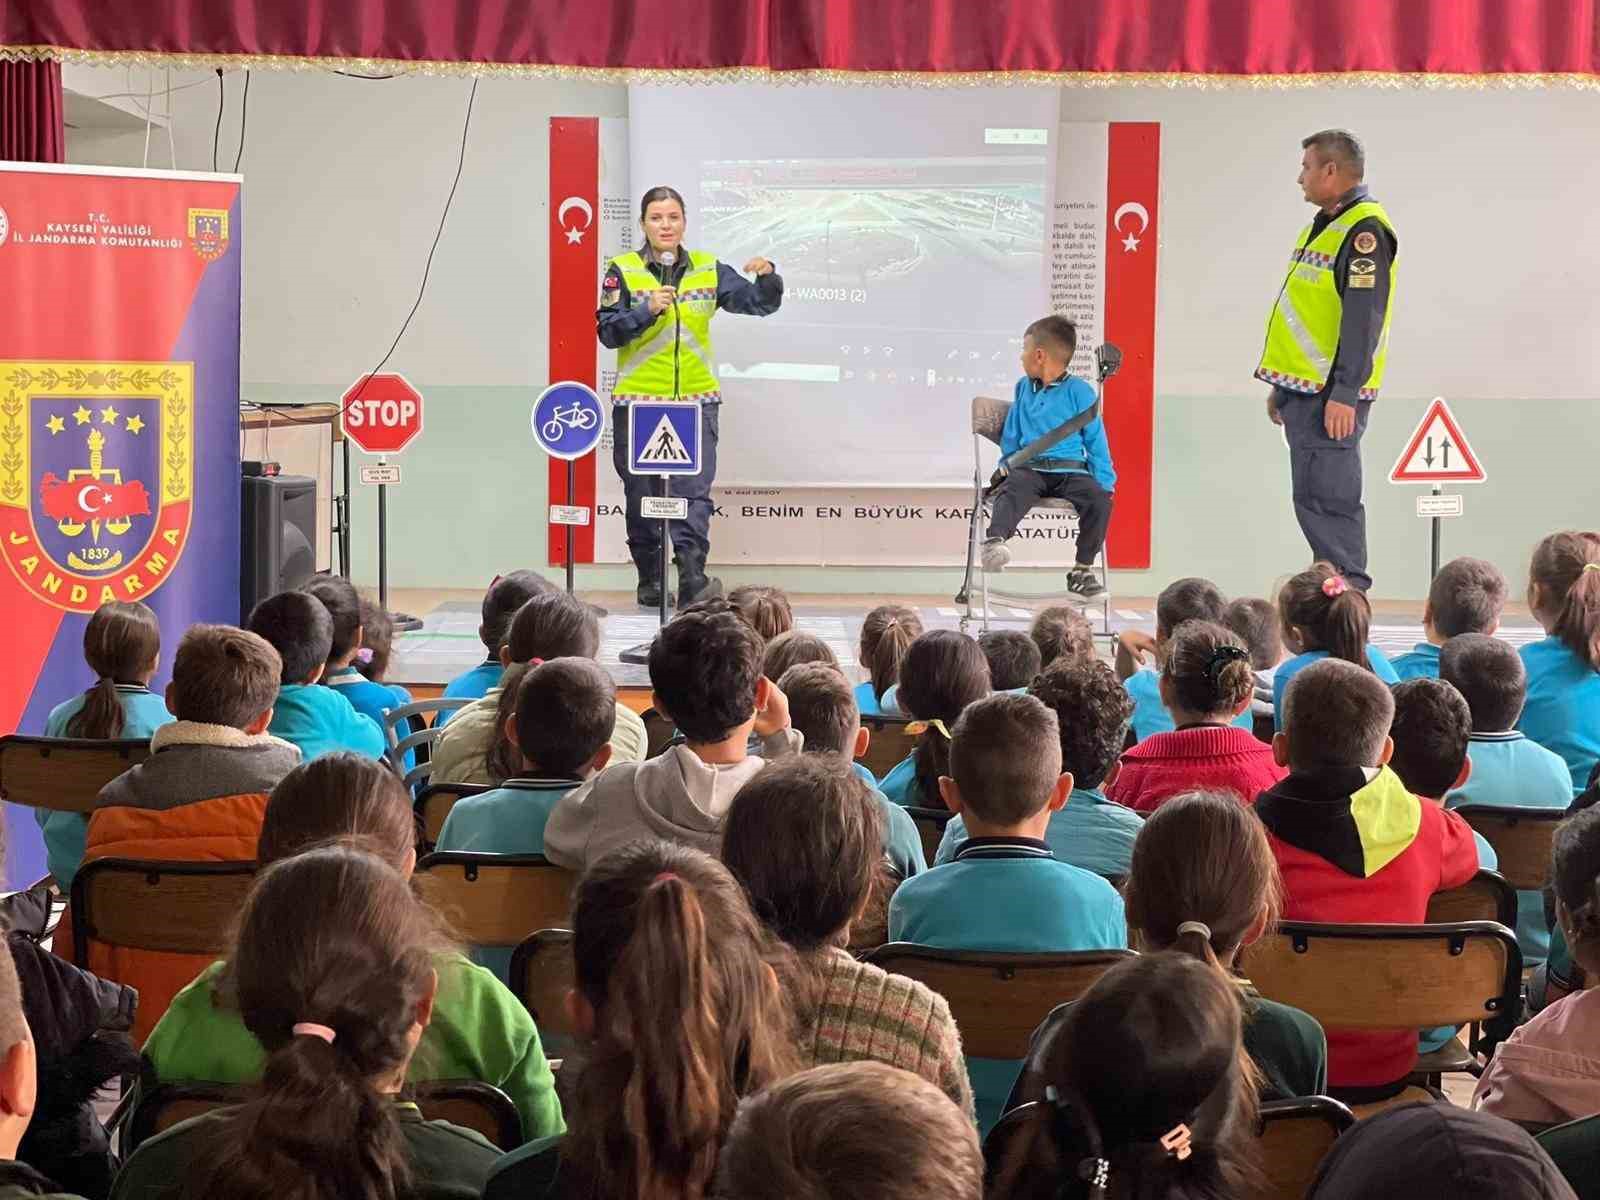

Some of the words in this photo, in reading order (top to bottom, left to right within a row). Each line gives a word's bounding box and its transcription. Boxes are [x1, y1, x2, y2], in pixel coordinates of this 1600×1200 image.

[88, 213, 109, 222] T.C.
[48, 223, 97, 234] KAYSERİ
[102, 225, 151, 236] VALİLİĞİ
[13, 232, 24, 242] İL
[28, 233, 96, 245] JANDARMA
[101, 237, 183, 248] KOMUTANLIĞI
[850, 288, 866, 304] (2)
[347, 400, 416, 427] STOP
[742, 505, 803, 518] BENİM
[816, 507, 842, 518] EN
[855, 505, 922, 519] BÜYÜK
[82, 548, 110, 560] 1839
[10, 528, 179, 604] JANDARMA
